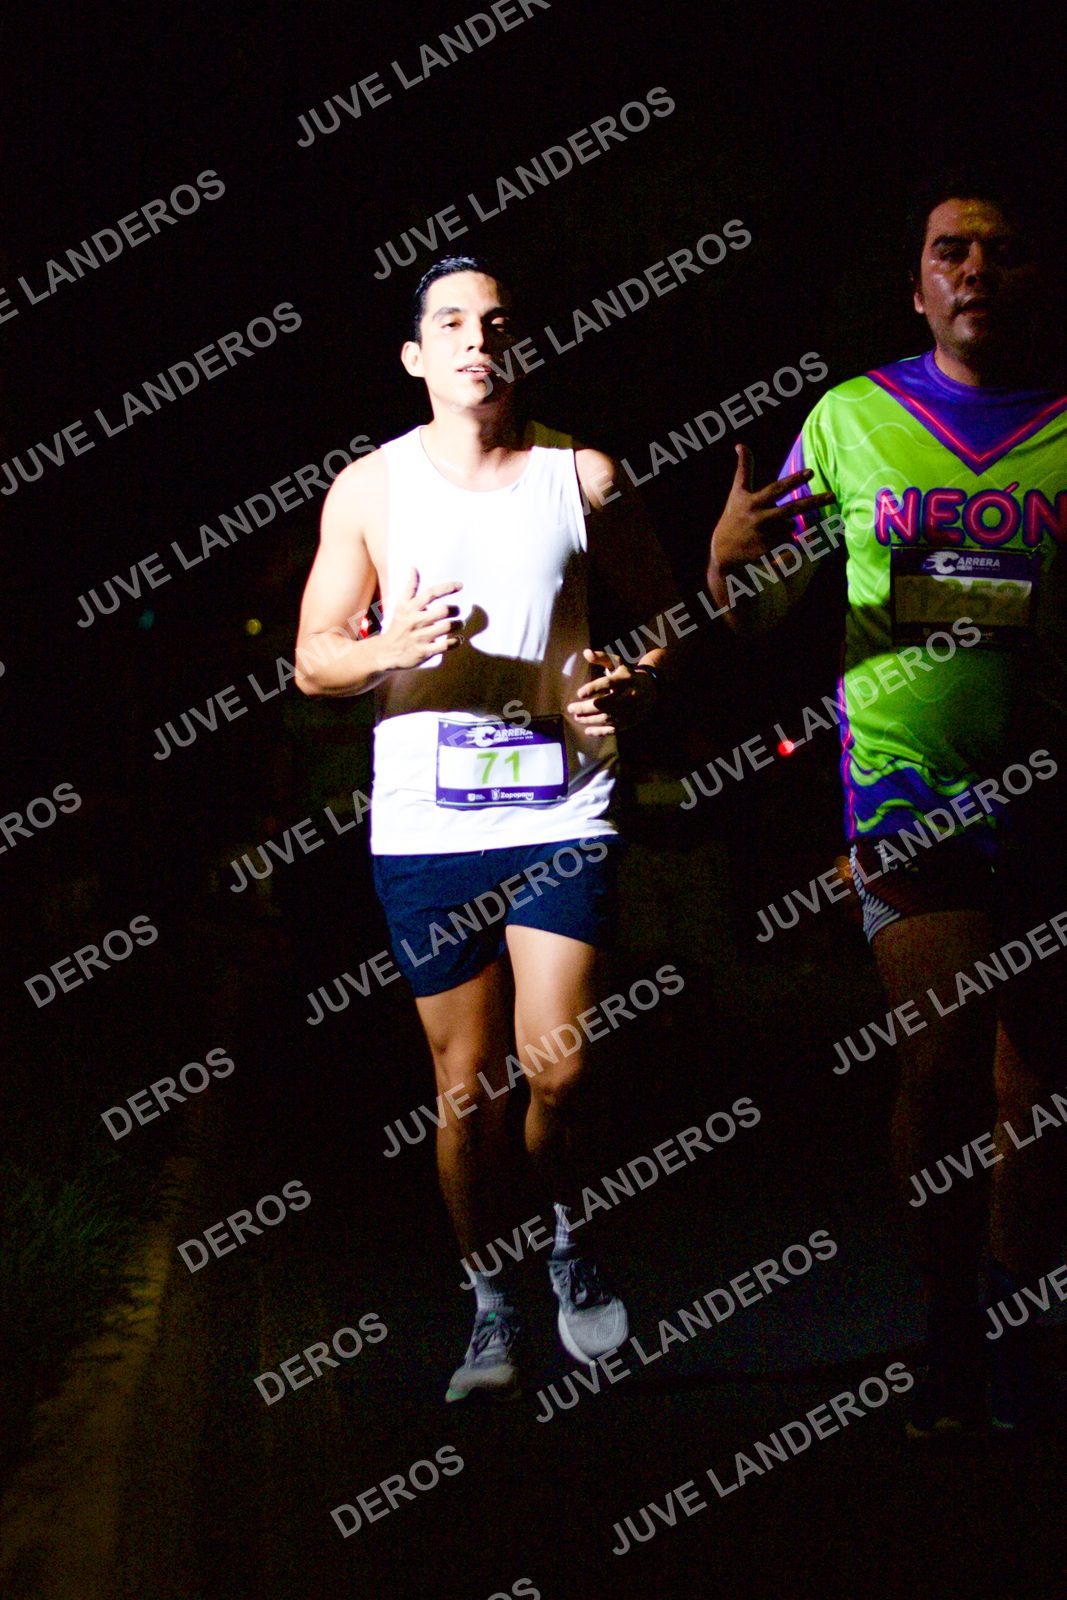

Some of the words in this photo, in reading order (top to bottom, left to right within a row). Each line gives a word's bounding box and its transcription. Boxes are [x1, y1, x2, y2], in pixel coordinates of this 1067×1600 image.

[875, 481, 1067, 548] NEÓN
[926, 551, 1001, 575] CARRERA
[466, 726, 534, 748] CARRERA
[476, 750, 521, 785] 71
